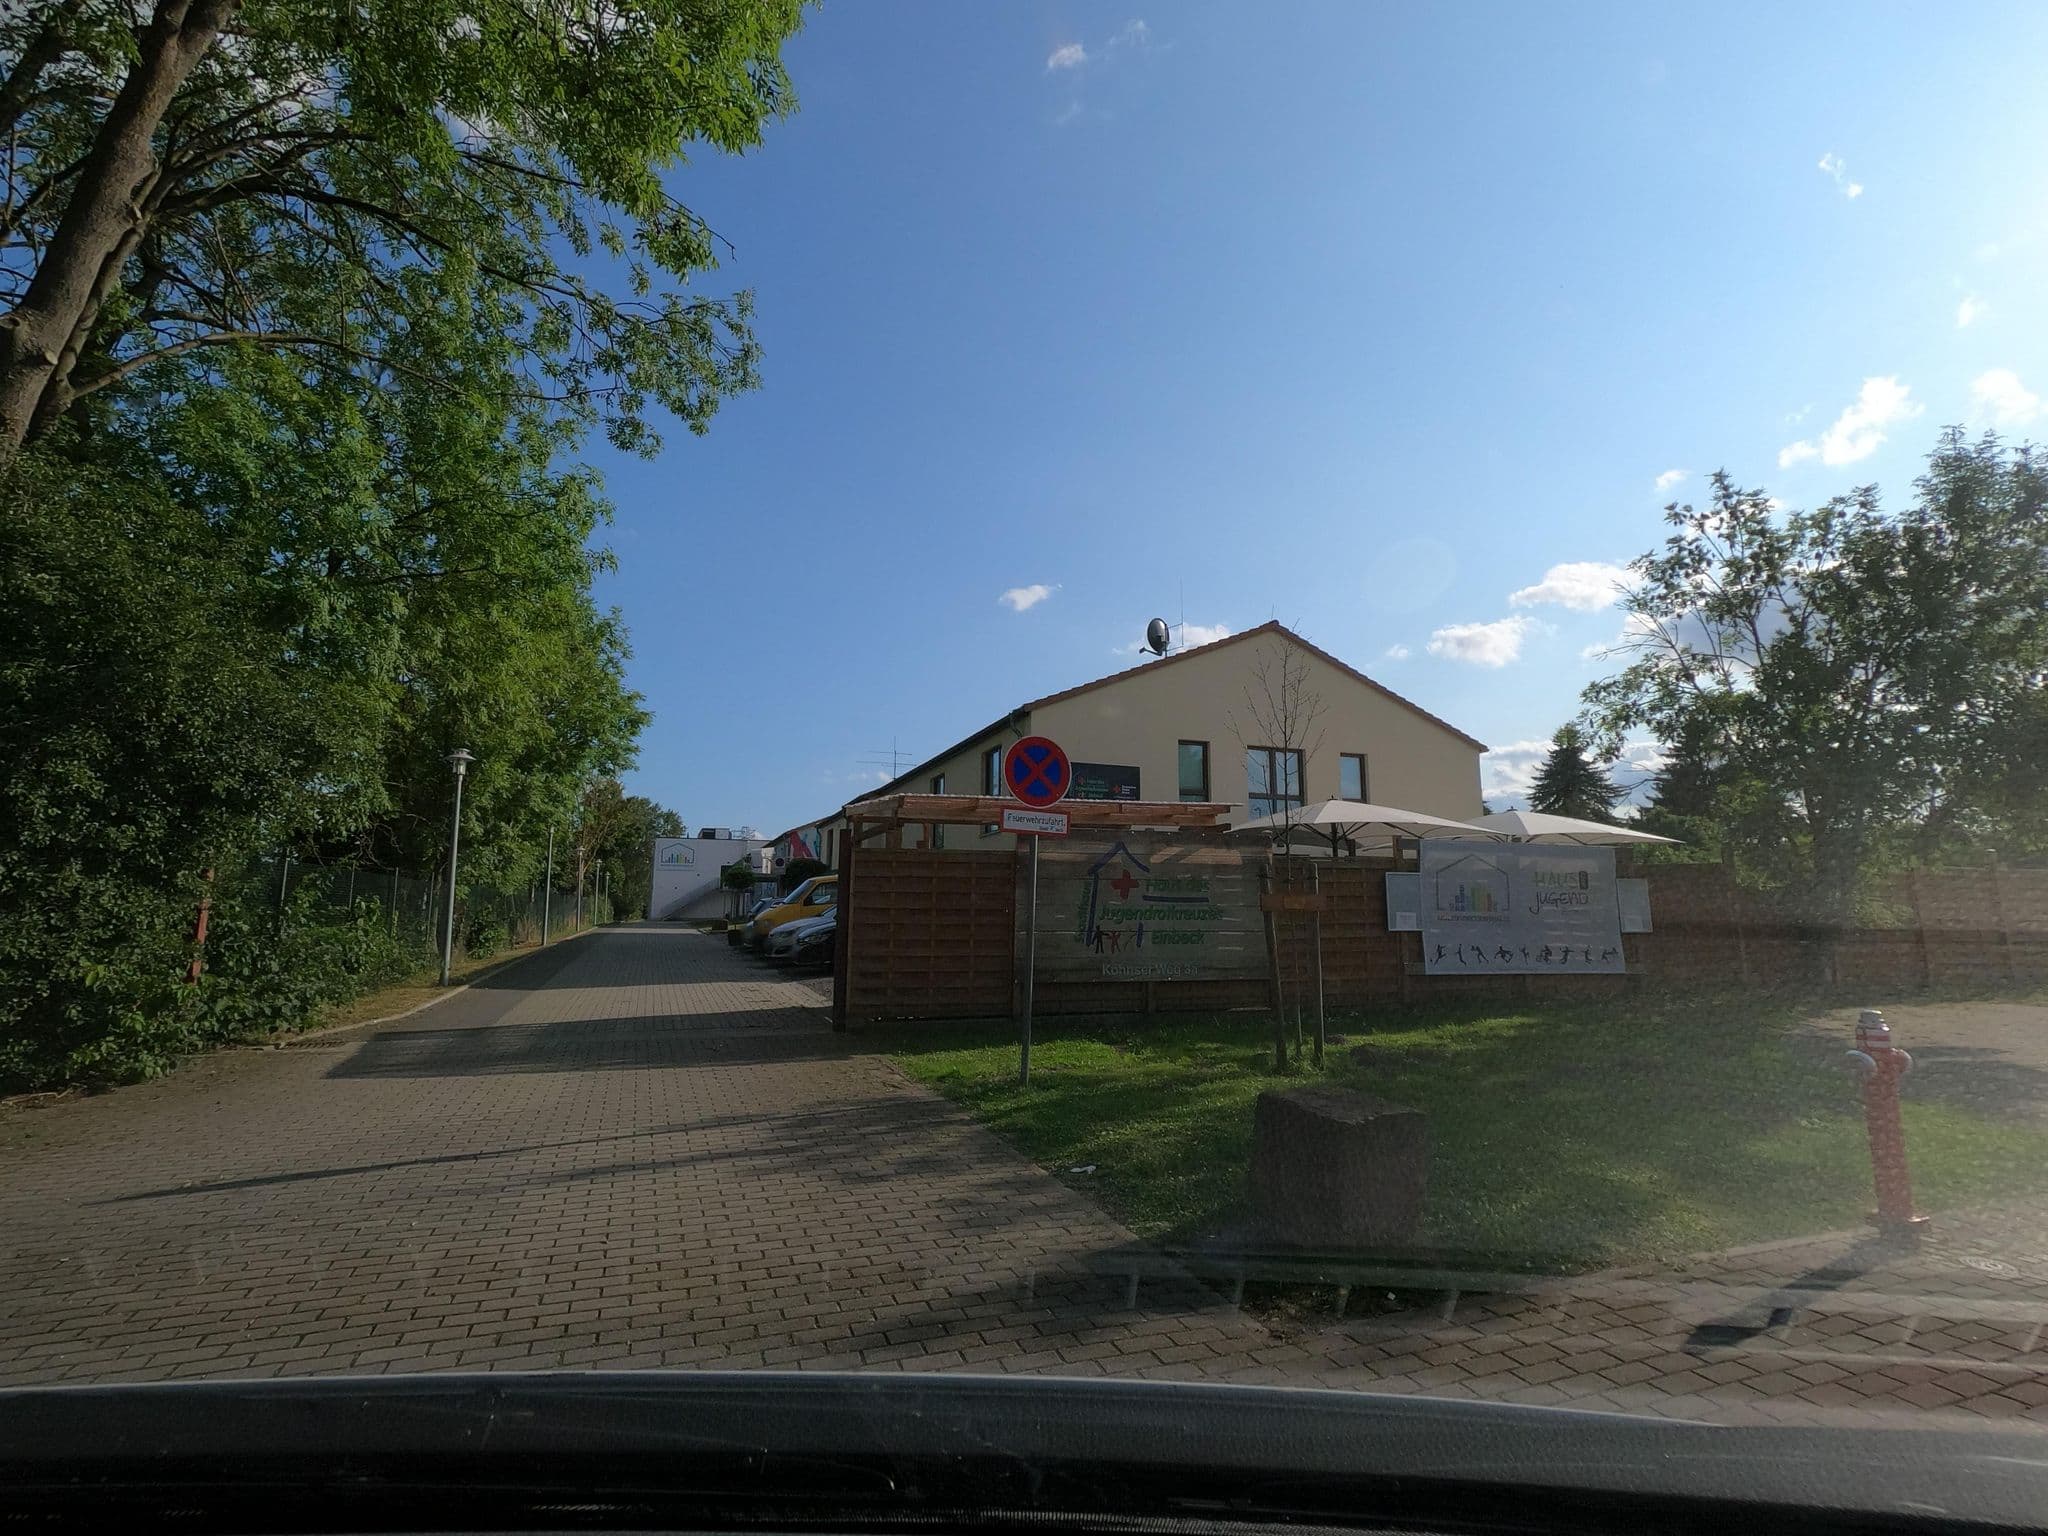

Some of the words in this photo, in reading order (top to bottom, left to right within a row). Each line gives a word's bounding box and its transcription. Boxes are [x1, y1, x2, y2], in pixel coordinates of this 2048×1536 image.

[1533, 870, 1579, 889] HAUS
[1099, 904, 1223, 923] Jugendrotkreuzes
[1151, 928, 1205, 945] Einbeck
[1103, 963, 1152, 976] Kohnser
[1155, 963, 1181, 977] Weg
